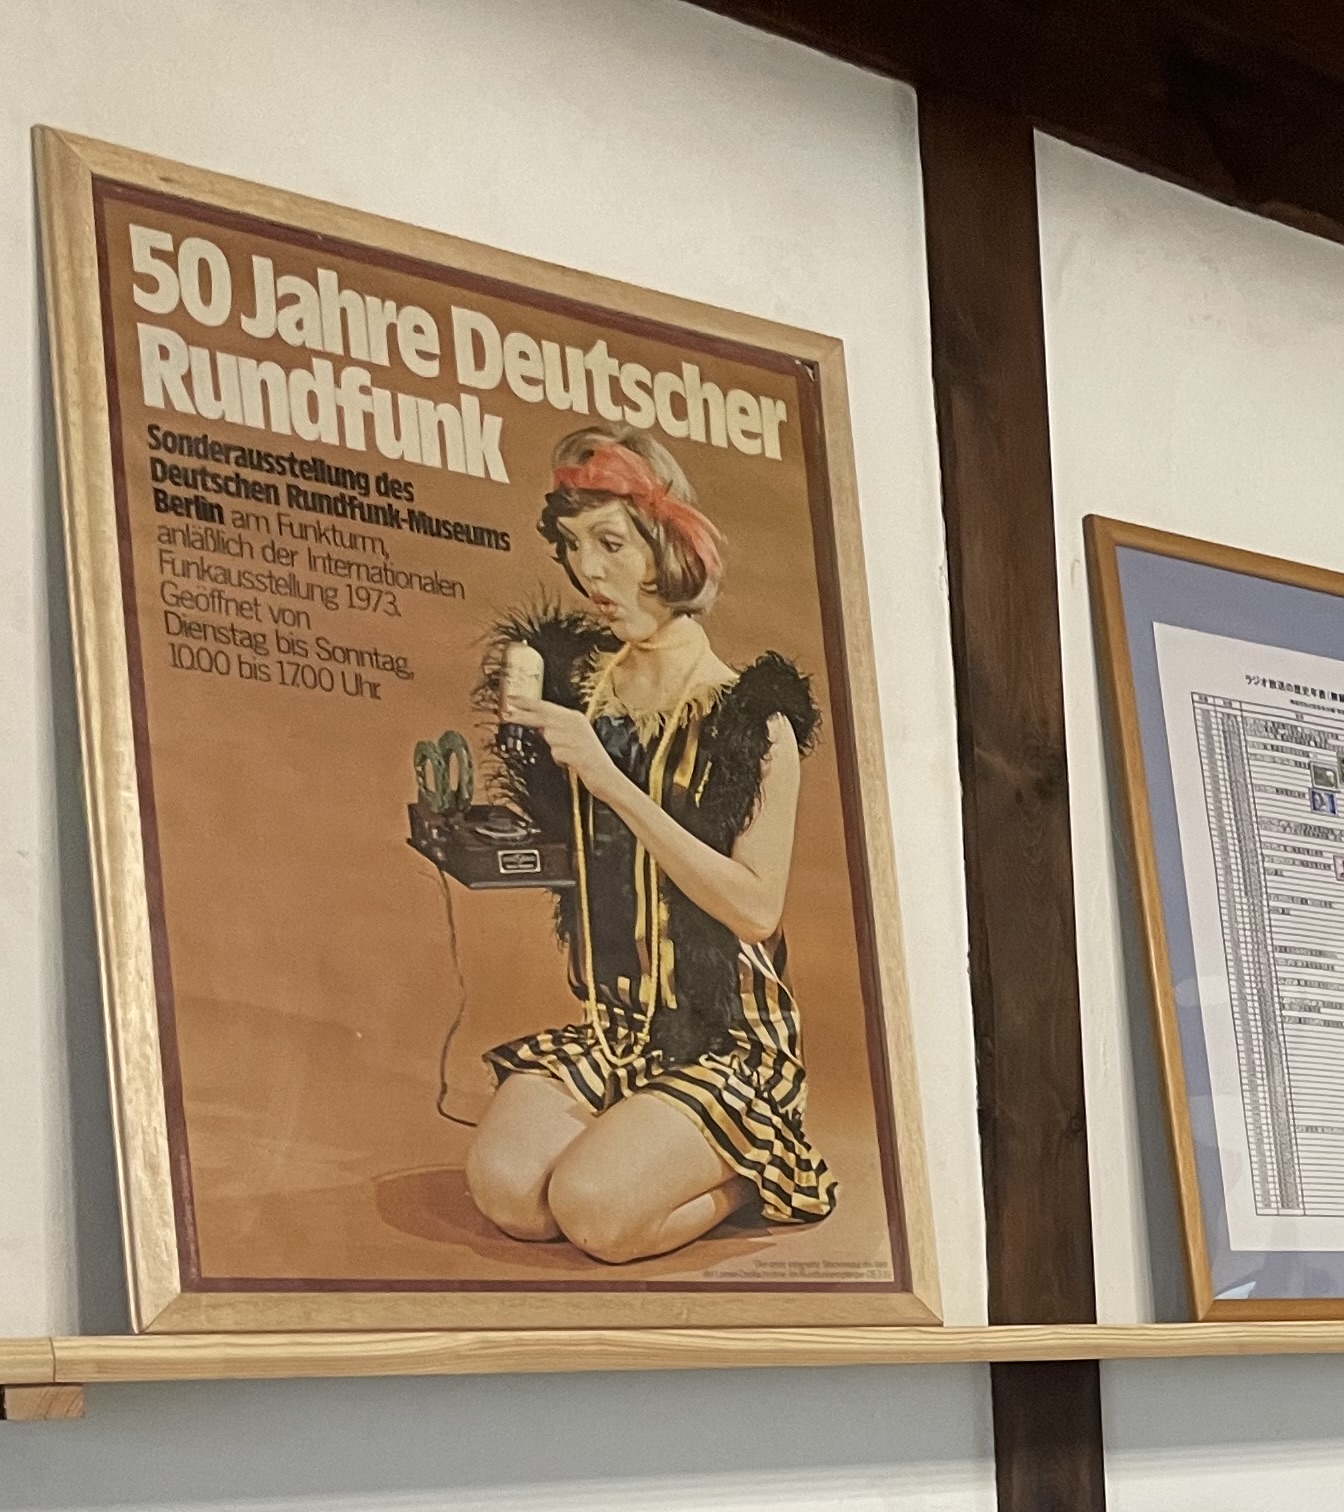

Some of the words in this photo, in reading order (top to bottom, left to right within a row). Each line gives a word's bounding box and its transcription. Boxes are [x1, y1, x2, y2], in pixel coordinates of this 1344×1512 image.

[128, 224, 232, 328] 50
[240, 254, 441, 378] Jahre
[450, 304, 789, 461] Deutscher
[135, 321, 511, 485] Rundfunk
[147, 423, 370, 494] Sonderausstellung
[375, 471, 415, 502] des
[149, 456, 280, 507] Deutschen
[286, 483, 511, 552] Rundfunk-Museums
[153, 487, 225, 526] Berlin
[231, 509, 271, 534] am
[278, 512, 390, 559] Funkturm,
[157, 523, 254, 560] anläßlich
[261, 538, 298, 568] der
[307, 546, 466, 600] Internationalen
[158, 548, 339, 612] Funkausstellung
[160, 581, 263, 622] Geöffnet
[269, 604, 311, 630] von
[163, 610, 268, 657] Dienstag
[275, 629, 309, 658] bis
[315, 636, 415, 681] Sonntag,
[237, 654, 272, 683] bis
